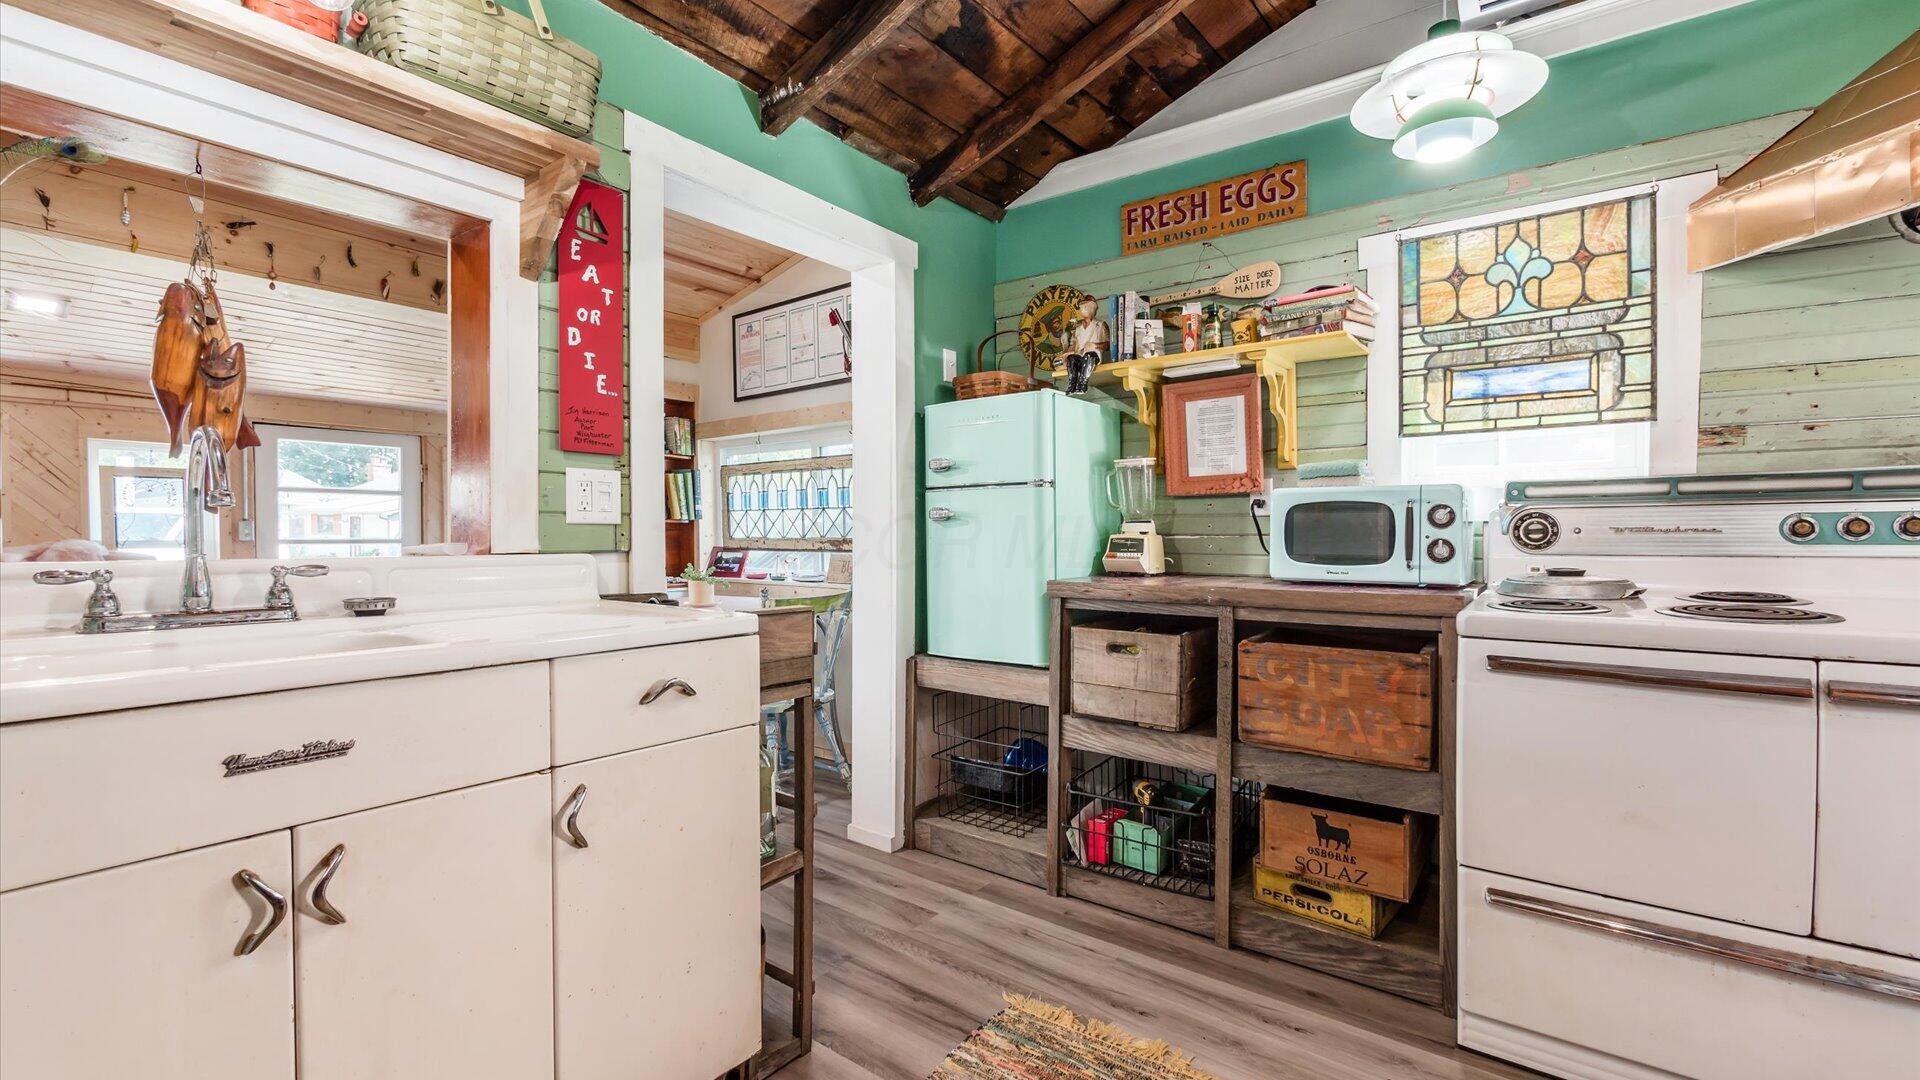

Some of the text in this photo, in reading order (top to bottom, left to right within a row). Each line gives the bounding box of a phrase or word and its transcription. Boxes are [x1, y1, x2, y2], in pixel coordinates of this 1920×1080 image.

[1126, 168, 1299, 237] FRESH EGGS
[1127, 238, 1158, 251] FARM
[1163, 225, 1208, 243] RAISED
[1220, 216, 1249, 231] LAID
[1257, 205, 1296, 222] DAILY
[1233, 268, 1275, 285] SIZE DOES
[1233, 278, 1274, 294] MATTER
[576, 307, 602, 327] OR
[1307, 846, 1357, 865] OSBORNE
[1294, 855, 1369, 887] SOLAZ
